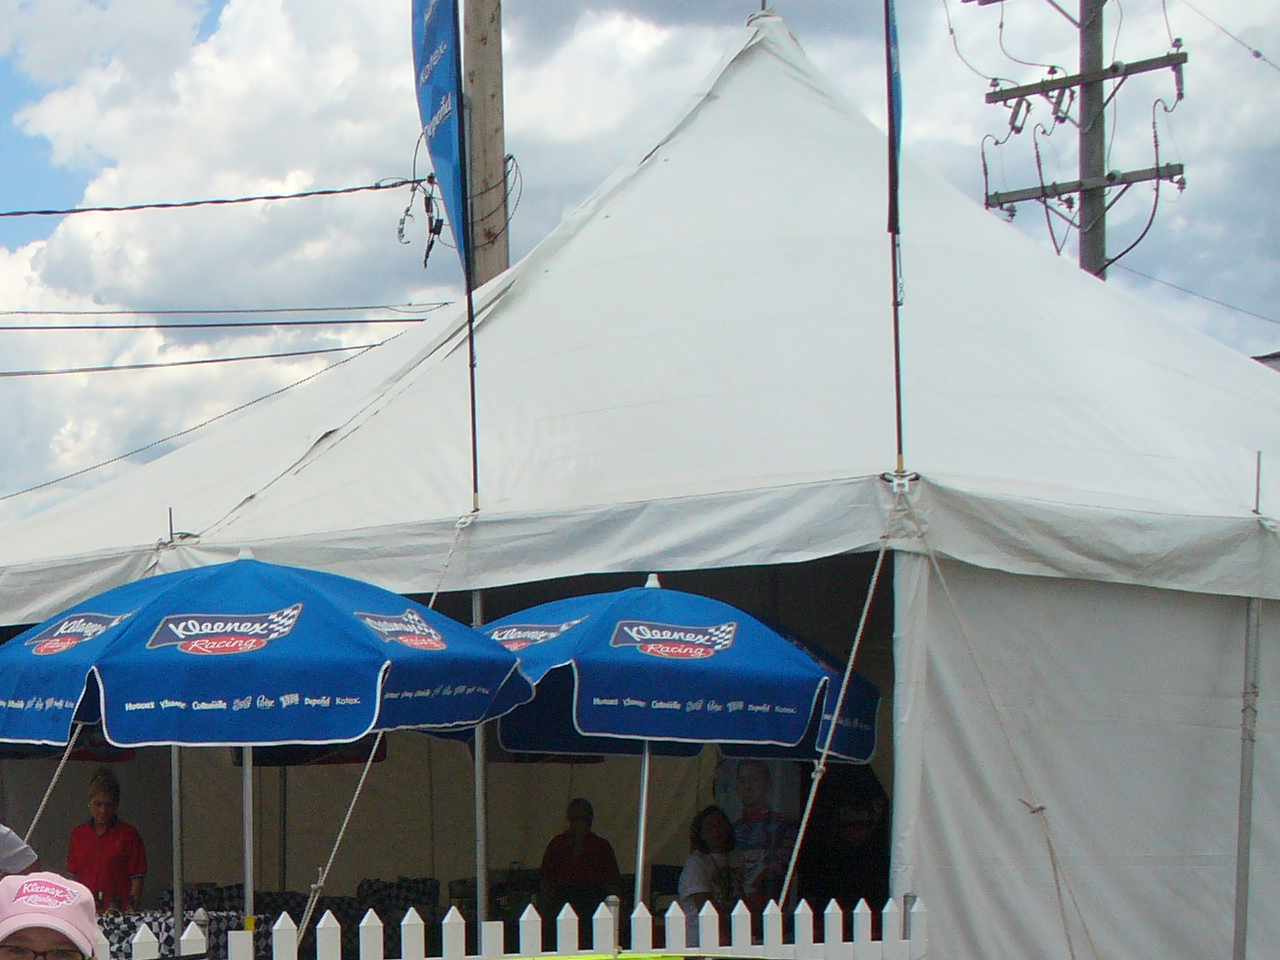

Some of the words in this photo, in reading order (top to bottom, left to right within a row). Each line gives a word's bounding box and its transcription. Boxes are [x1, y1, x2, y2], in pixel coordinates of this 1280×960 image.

[168, 615, 270, 641] Kleenex
[622, 623, 713, 647] Kleenex
[188, 636, 260, 653] Racing
[646, 642, 706, 658] Racing
